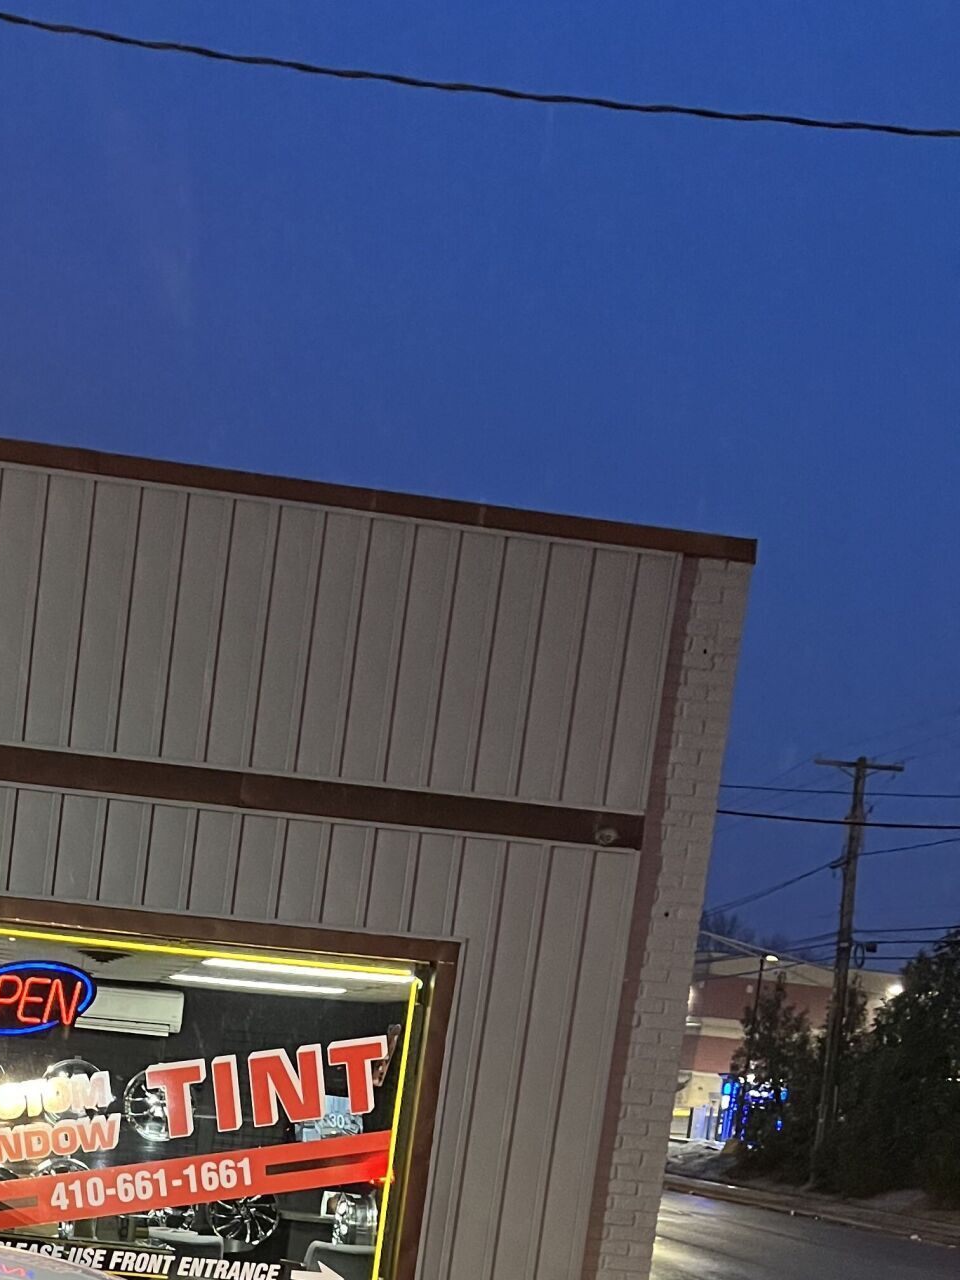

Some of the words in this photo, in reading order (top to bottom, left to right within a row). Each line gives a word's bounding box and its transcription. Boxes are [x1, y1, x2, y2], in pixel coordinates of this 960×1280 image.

[146, 1035, 393, 1139] TINT
[328, 1113, 345, 1129] 30
[50, 1157, 252, 1211] 410-661-1661
[67, 1246, 106, 1269] USE
[108, 1250, 176, 1275] FRONT
